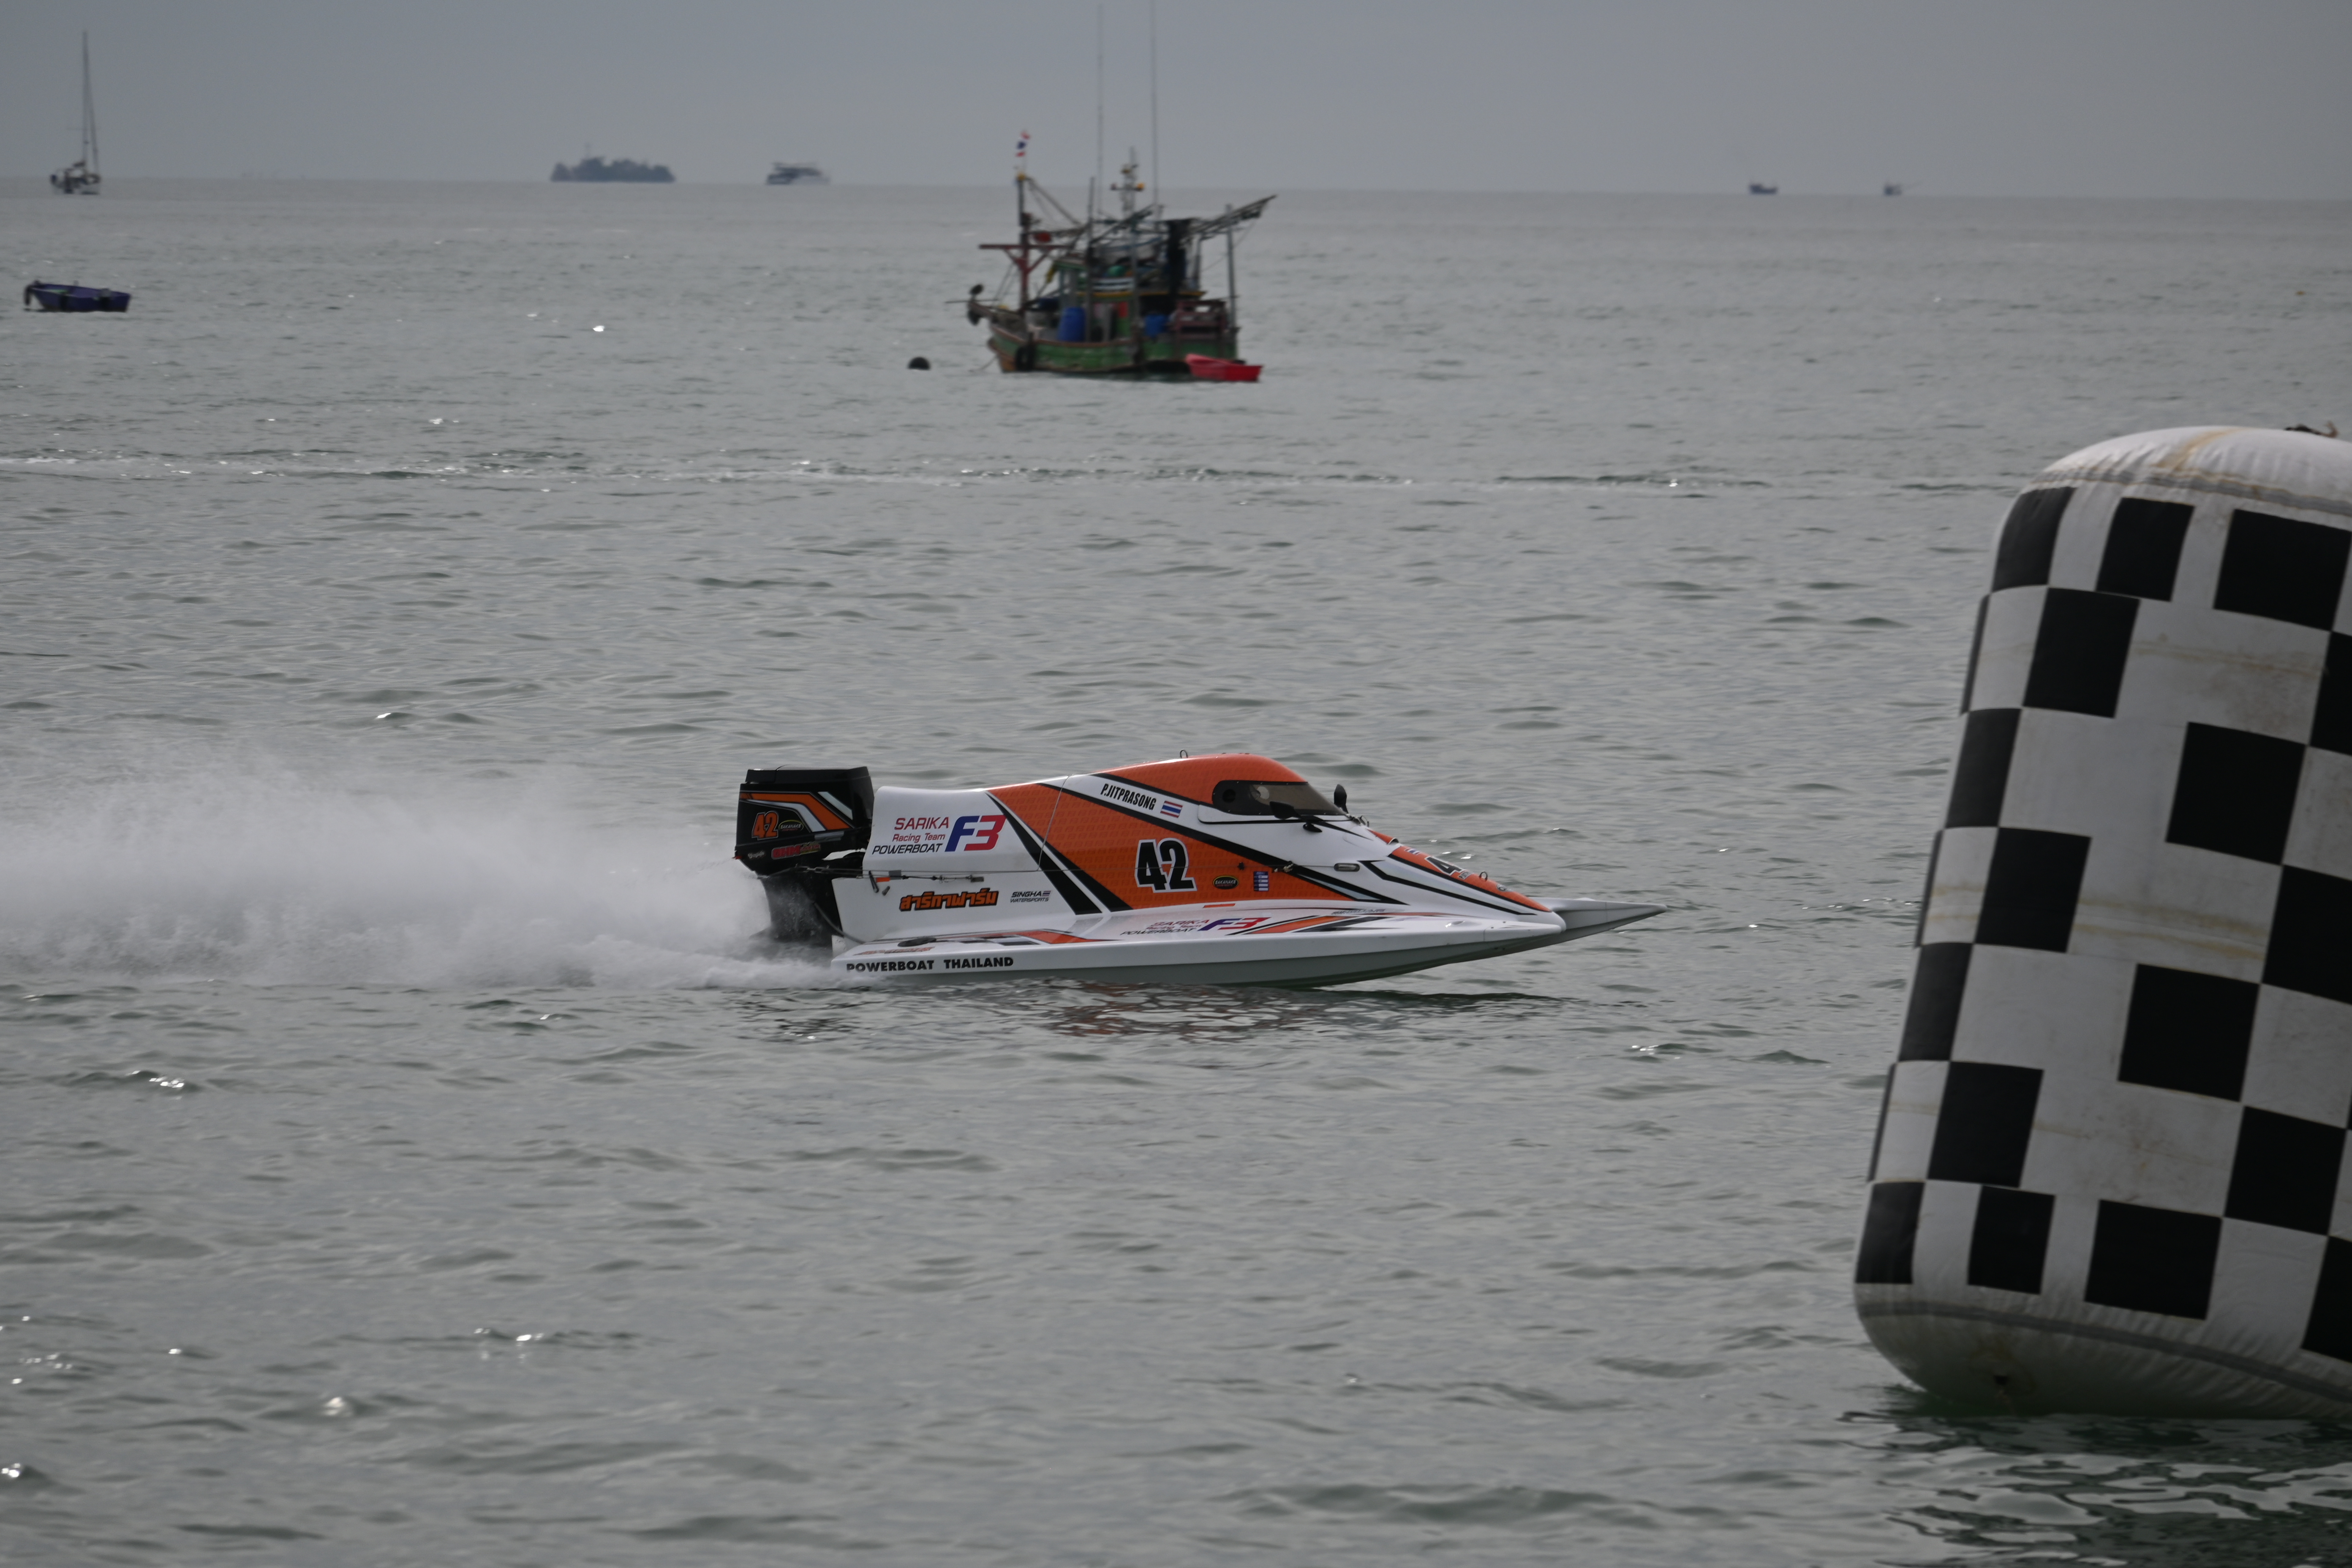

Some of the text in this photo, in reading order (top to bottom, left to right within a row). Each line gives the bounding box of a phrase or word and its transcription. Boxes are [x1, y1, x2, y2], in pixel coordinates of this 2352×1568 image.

[1100, 783, 1157, 811] P.JITPRASONG
[752, 811, 778, 839] 42
[894, 817, 949, 830] SARIKA
[892, 833, 945, 843] Racing Team
[945, 815, 1007, 852] F3
[872, 843, 943, 855] POWERBOAT
[1135, 838, 1196, 892] 42
[899, 888, 999, 912] สาริกาฟาร์ม
[1197, 917, 1272, 931] F3
[847, 957, 1014, 972] POWERBOAT THAILAND
